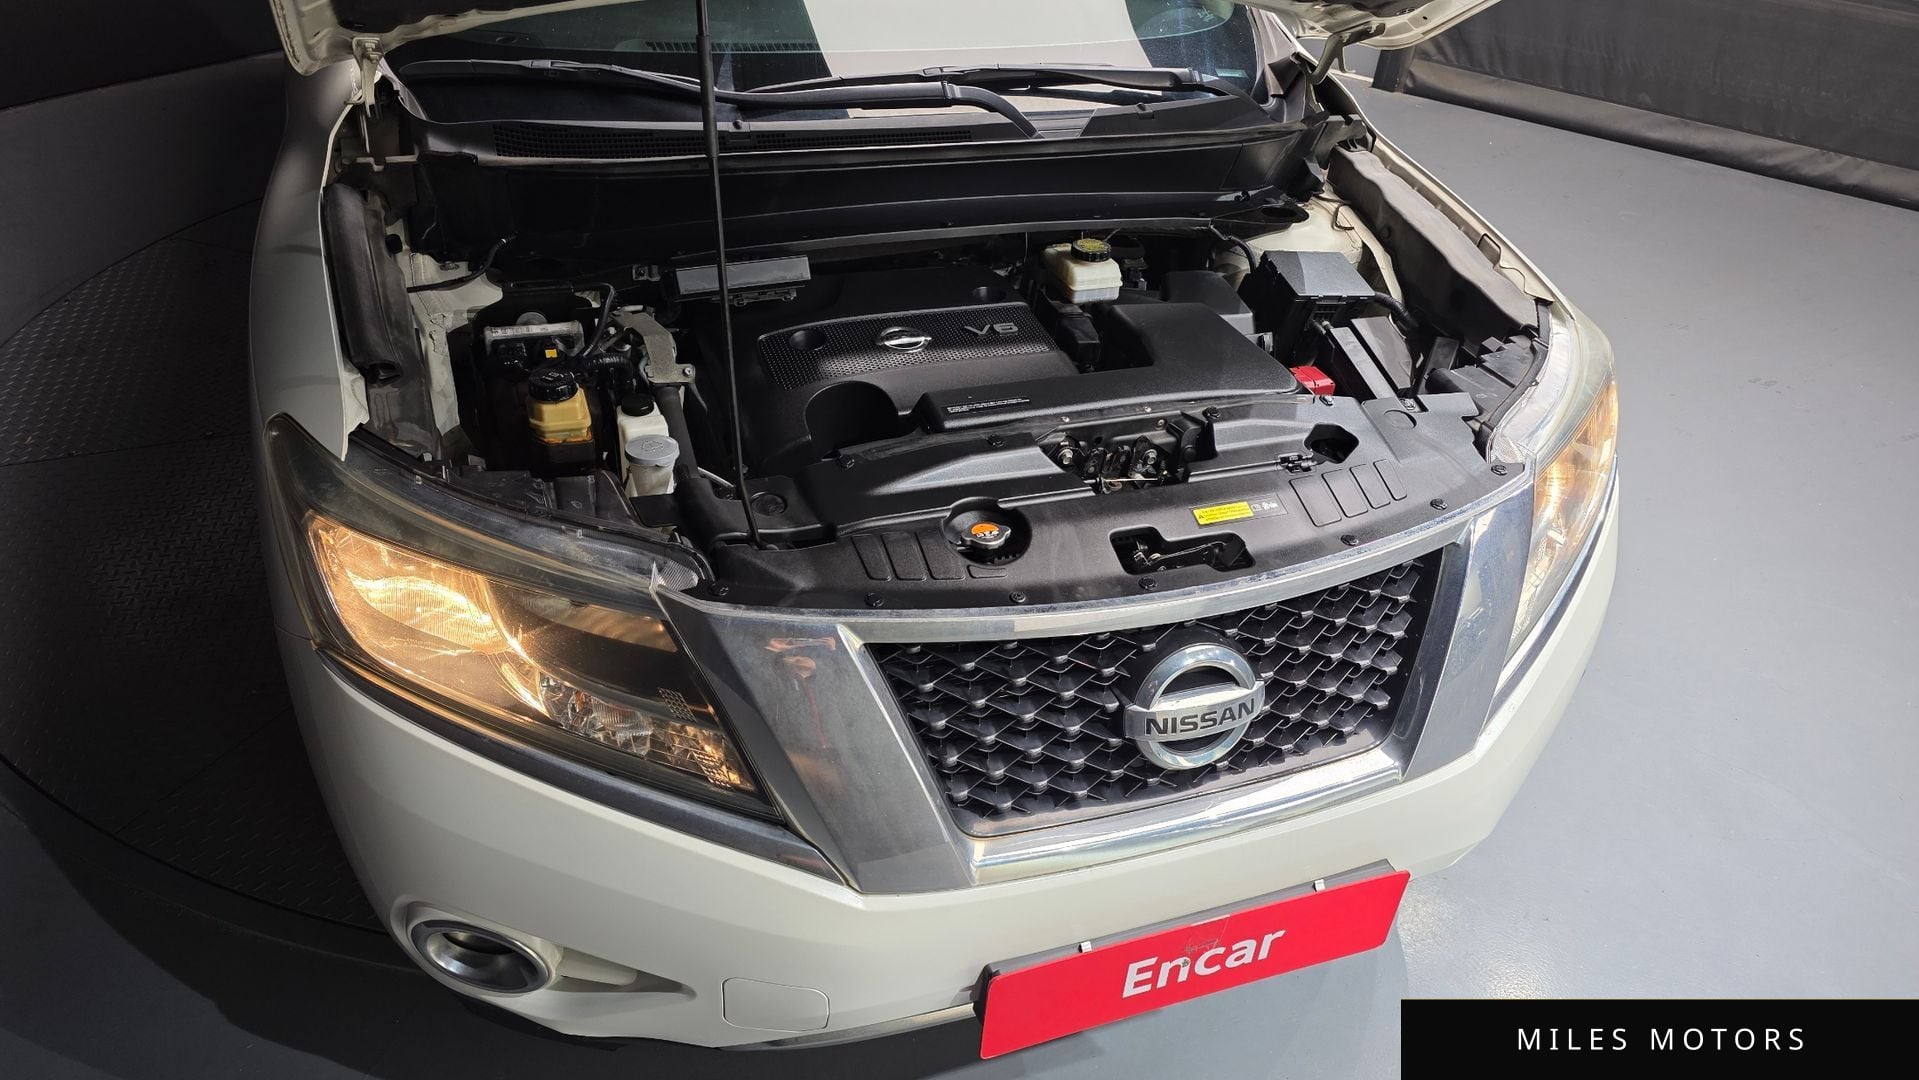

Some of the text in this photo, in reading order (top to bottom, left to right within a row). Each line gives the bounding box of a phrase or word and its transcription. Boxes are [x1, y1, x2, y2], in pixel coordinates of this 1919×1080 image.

[964, 322, 1019, 335] V6
[1145, 698, 1255, 735] NISSAN
[1122, 930, 1286, 998] Encar
